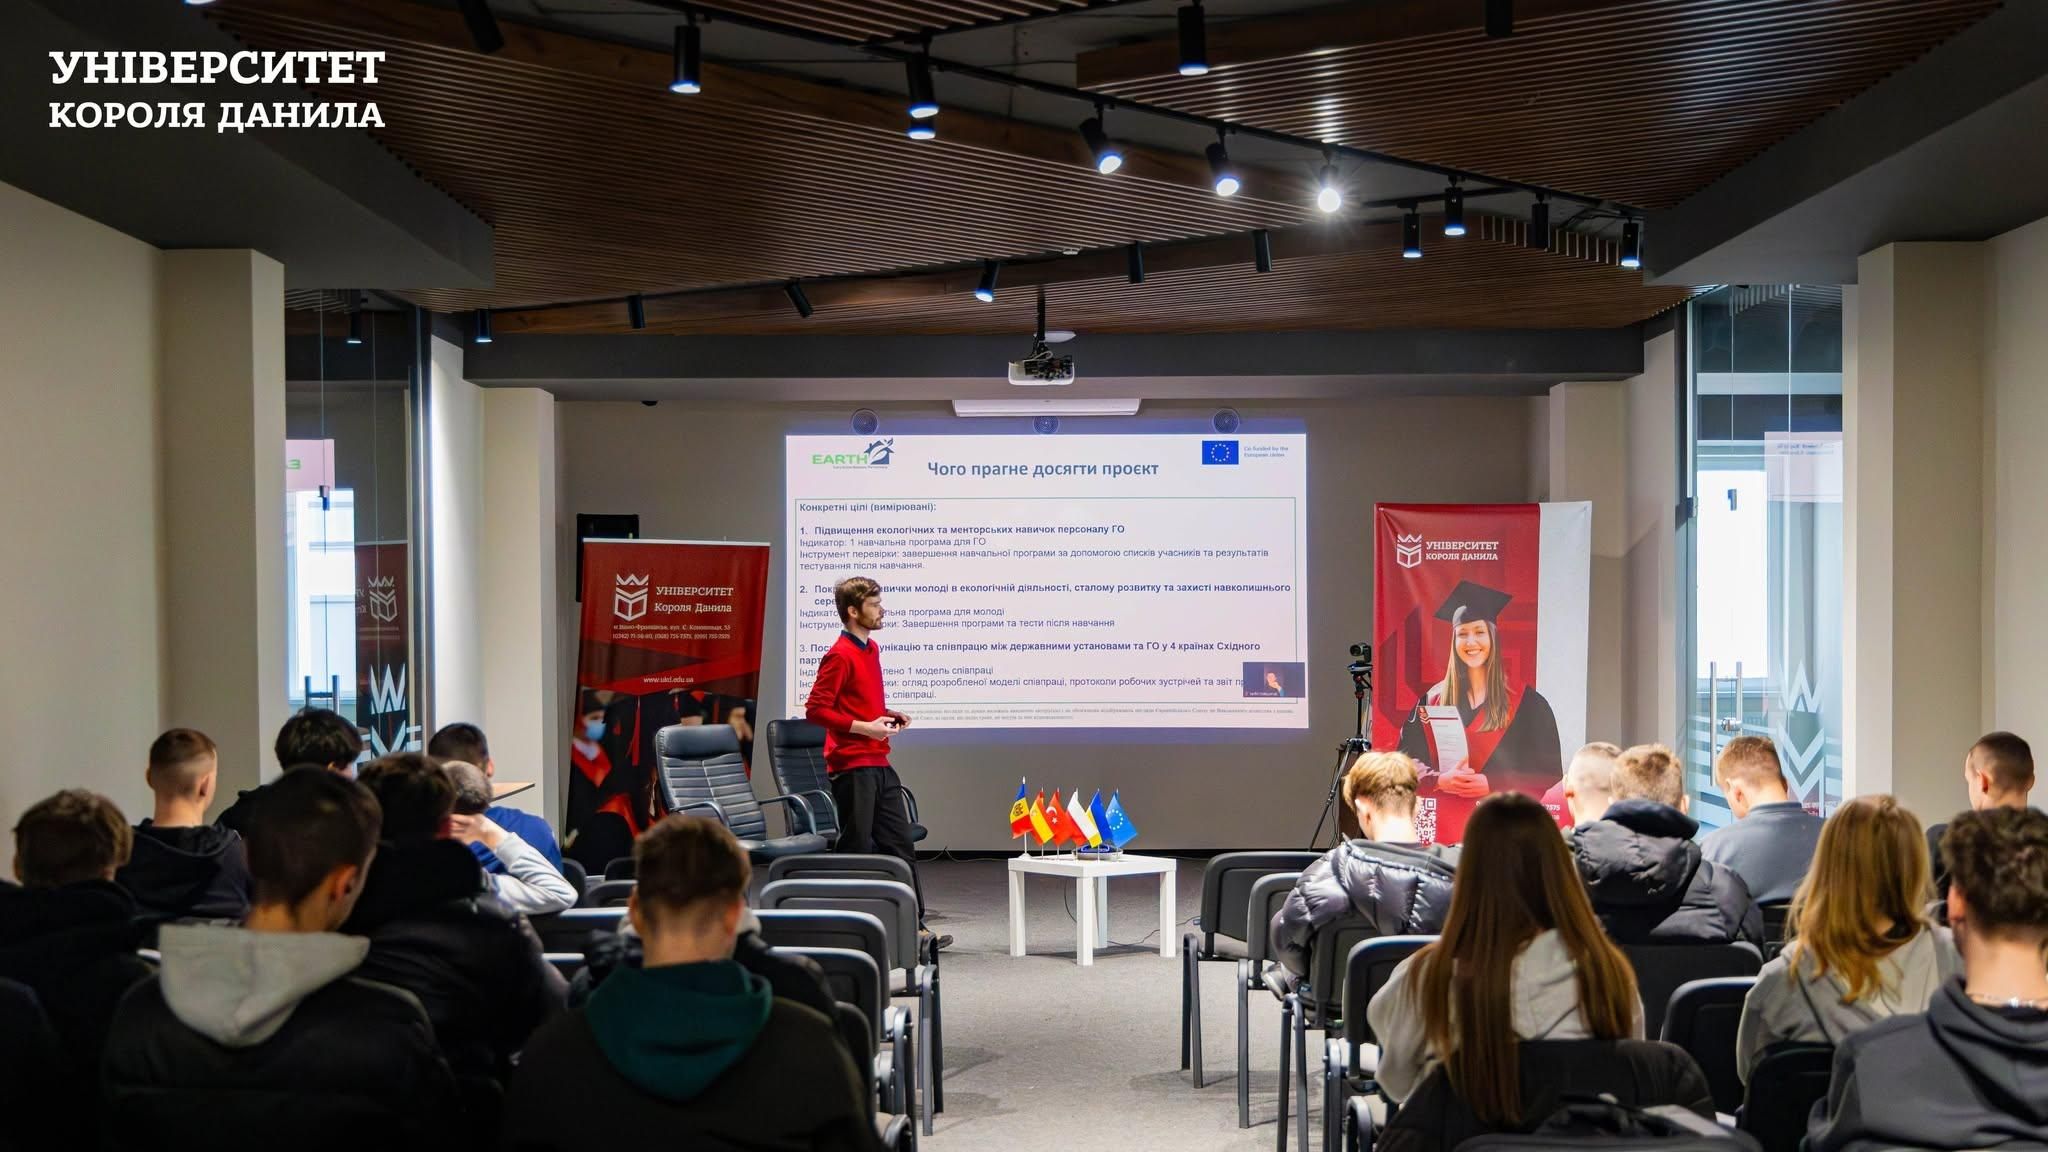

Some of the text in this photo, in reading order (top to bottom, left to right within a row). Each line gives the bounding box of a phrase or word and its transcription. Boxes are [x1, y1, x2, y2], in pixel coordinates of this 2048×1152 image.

[812, 454, 867, 464] EARTH
[928, 462, 1159, 478] Чого прагне досягти проєкт
[800, 503, 936, 512] Конкретні цілі (вимірювані):
[815, 527, 873, 535] Підвищення
[951, 527, 1012, 535] менторських
[1058, 527, 1109, 535] персоналу
[1112, 525, 1124, 533] ГО
[800, 539, 846, 548] Індикатор:
[909, 539, 951, 547] програма
[973, 537, 986, 545] ГО
[1426, 541, 1499, 550] УНІВЕРСИТЕТ
[800, 551, 850, 560] Інструмент
[853, 550, 899, 559] перевірки:
[902, 551, 957, 559] завершення
[960, 549, 1010, 557] навчальної
[1013, 551, 1055, 559] програми
[1070, 550, 1120, 558] допомогою
[1158, 549, 1200, 558] учасників
[1216, 550, 1268, 558] результатів
[1462, 553, 1498, 562] ДАНИЛА
[800, 563, 851, 571] тестування
[656, 587, 734, 596] УНІВЕРСИТЕТ
[915, 584, 948, 592] молоді
[960, 584, 1015, 592] екологічній
[1018, 584, 1071, 592] діяльності,
[1075, 585, 1114, 593] сталому
[1118, 585, 1161, 593] розвитку
[654, 602, 732, 614] Короля Данила
[974, 608, 1004, 616] молоді
[902, 620, 958, 629] Завершення
[962, 621, 1004, 629] програми
[937, 643, 988, 652] співпрацю
[1010, 644, 1070, 652] державними
[1073, 644, 1130, 652] установами
[1147, 642, 1159, 650] ГО
[1179, 642, 1214, 652] країнах
[1217, 642, 1260, 651] Східного
[1070, 679, 1116, 687] протоколи
[1119, 677, 1156, 687] робочих
